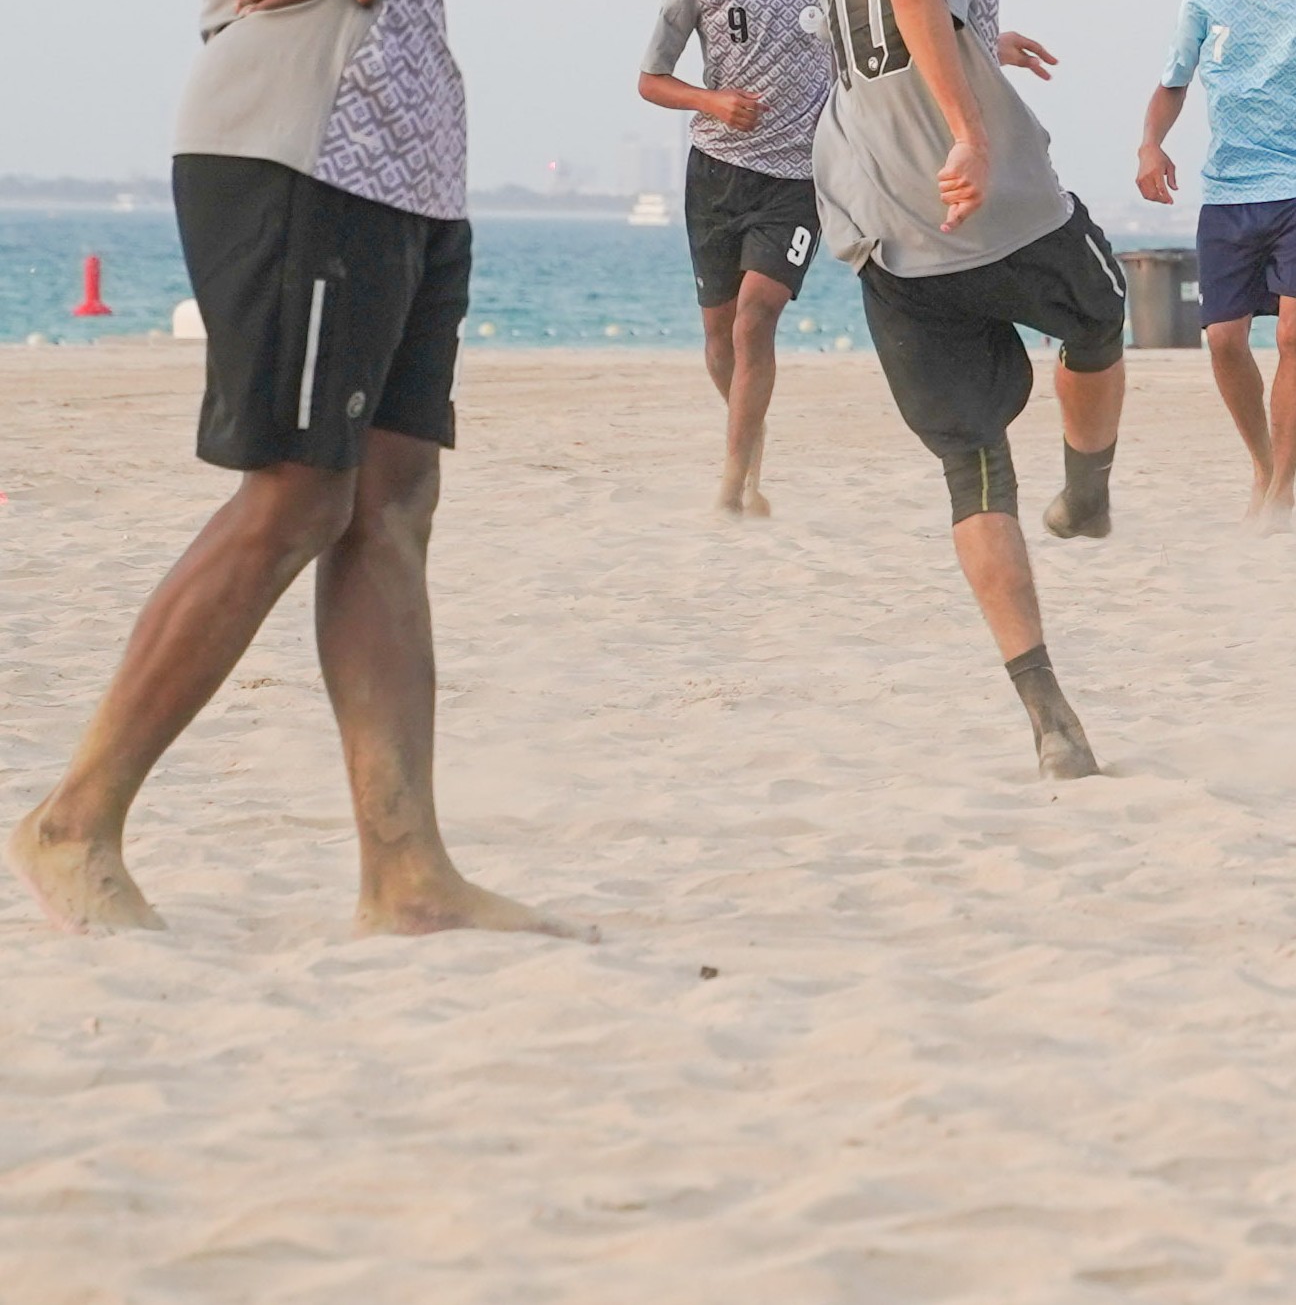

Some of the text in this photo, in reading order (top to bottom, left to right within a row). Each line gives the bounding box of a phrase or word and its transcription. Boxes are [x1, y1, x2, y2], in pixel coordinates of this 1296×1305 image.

[728, 7, 748, 43] 9
[1211, 25, 1230, 63] 7
[786, 226, 811, 266] 9
